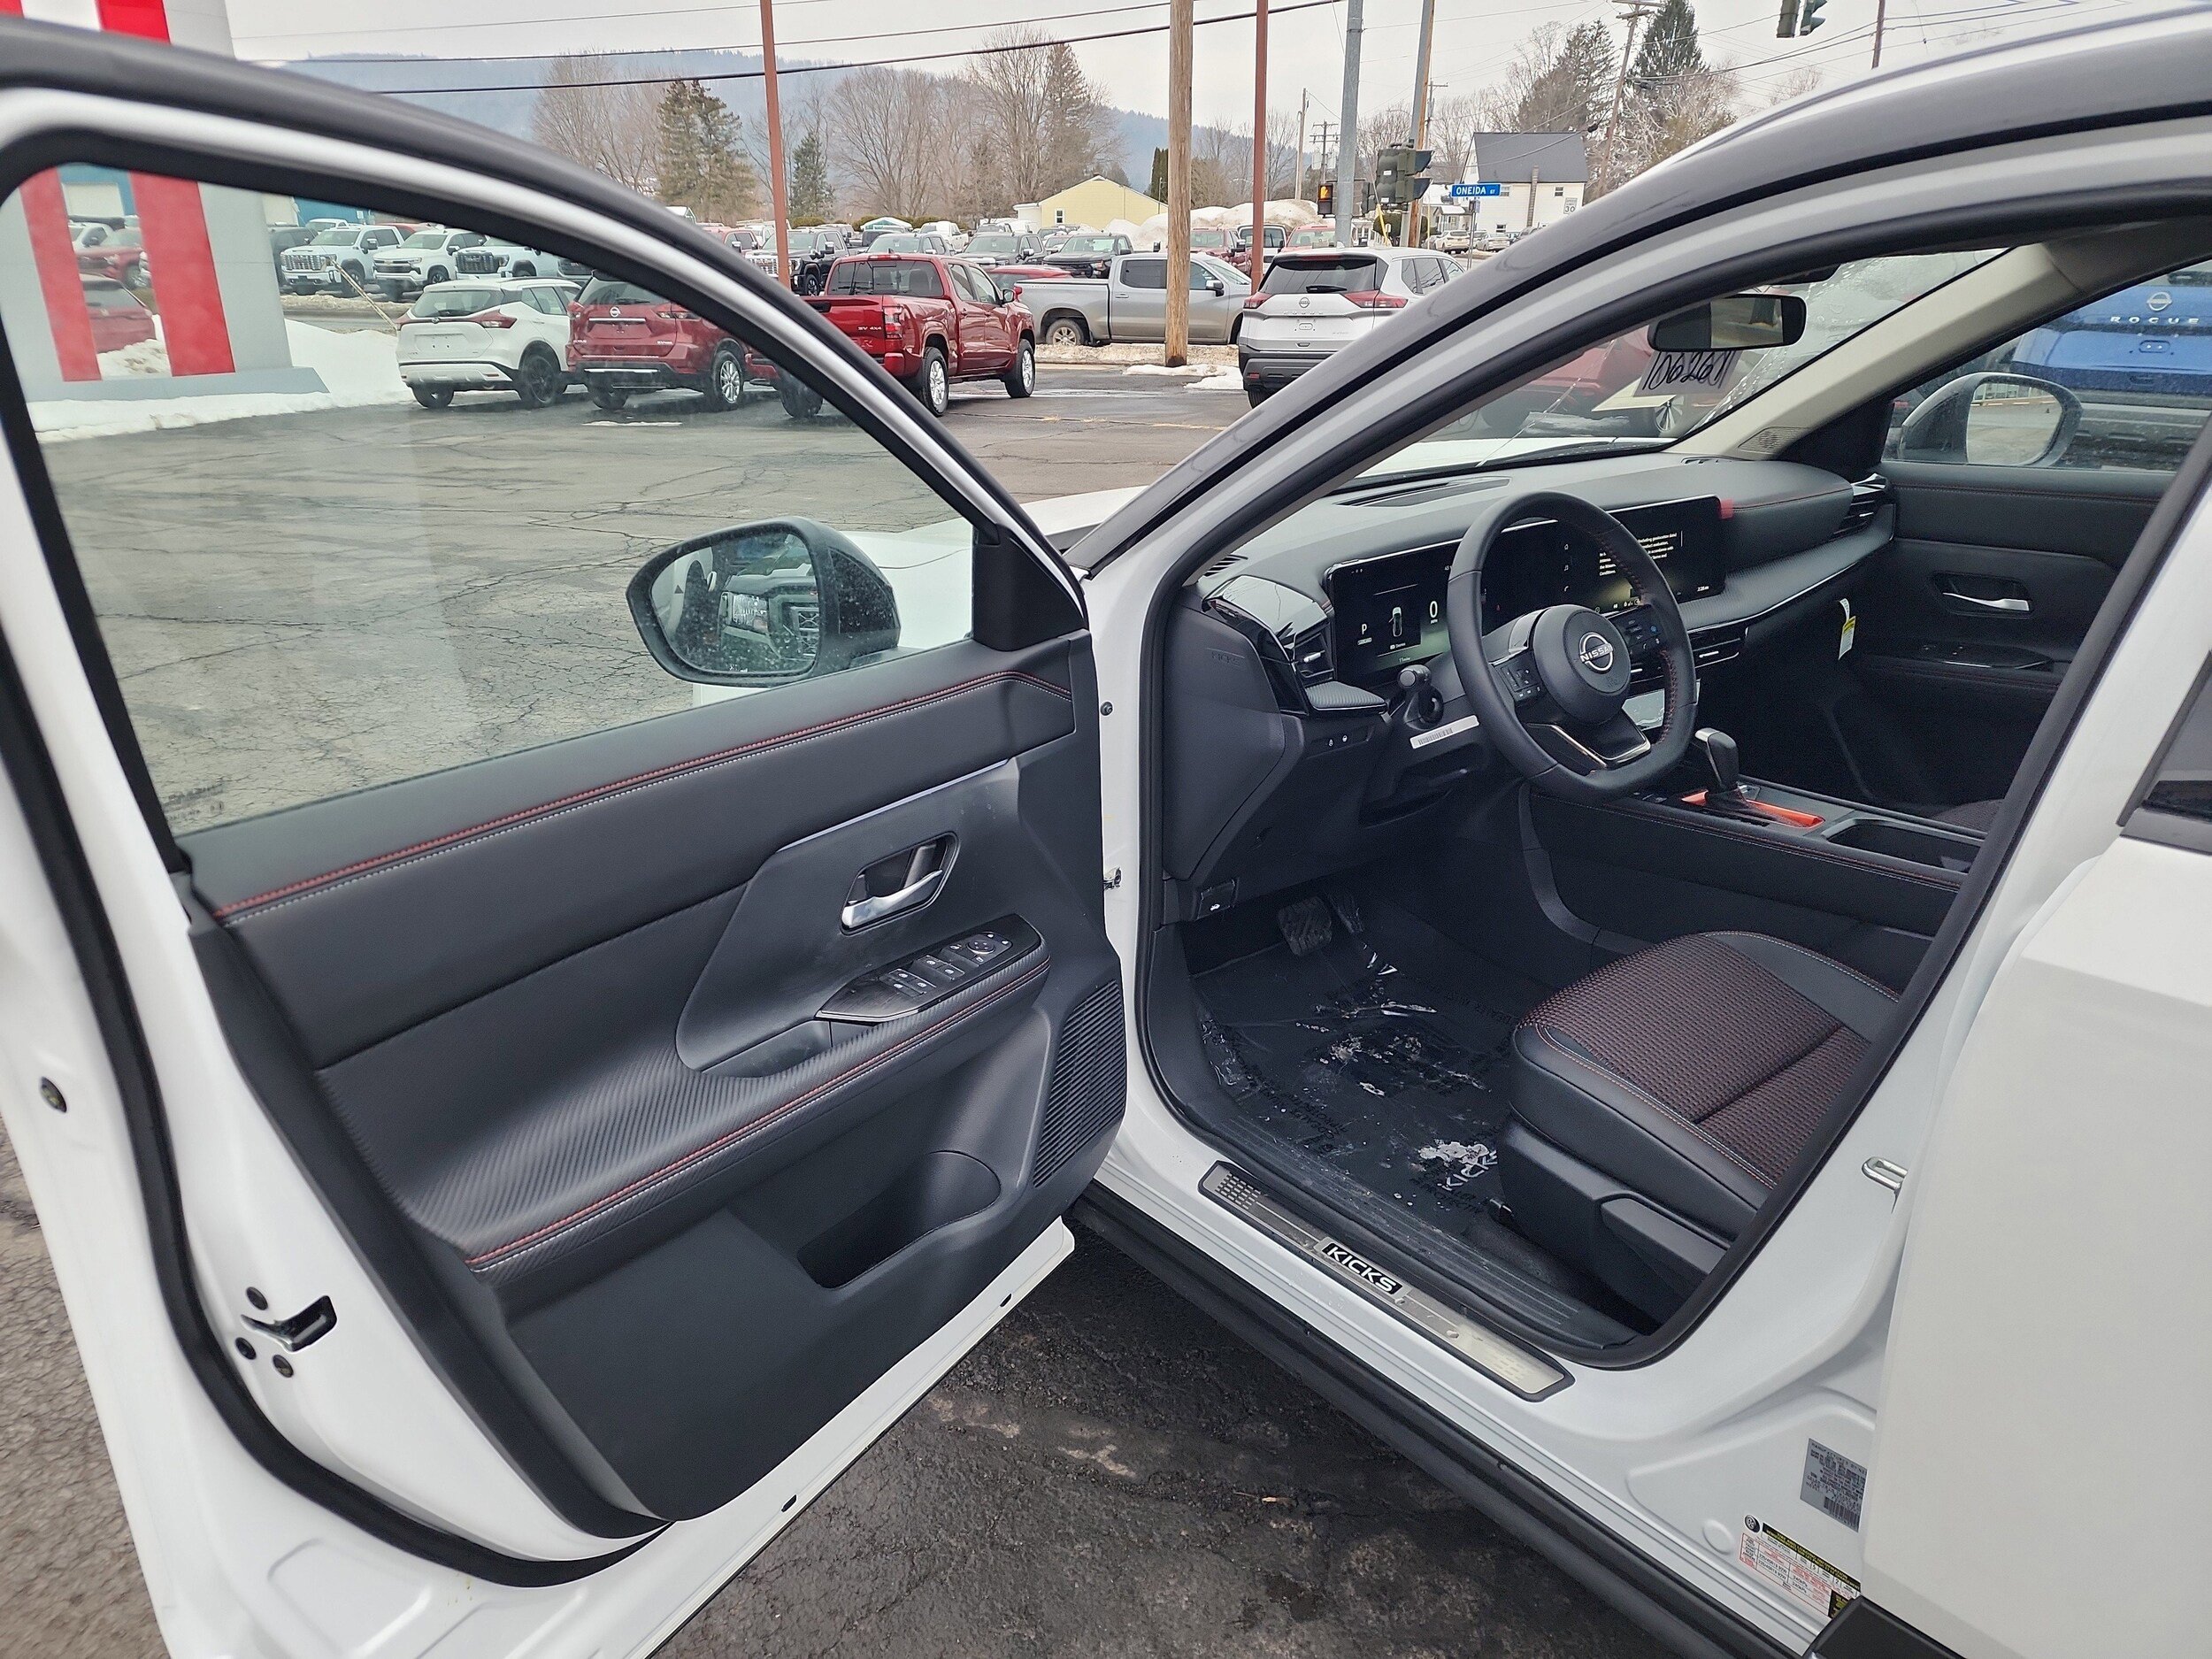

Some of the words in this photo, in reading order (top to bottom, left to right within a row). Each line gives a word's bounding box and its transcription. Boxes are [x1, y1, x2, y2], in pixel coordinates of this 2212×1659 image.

[2110, 316, 2199, 325] ROGUE
[1429, 601, 1439, 618] 0
[1362, 623, 1368, 635] P
[1579, 644, 1612, 663] NISSAN
[1327, 1246, 1396, 1292] KICKS
